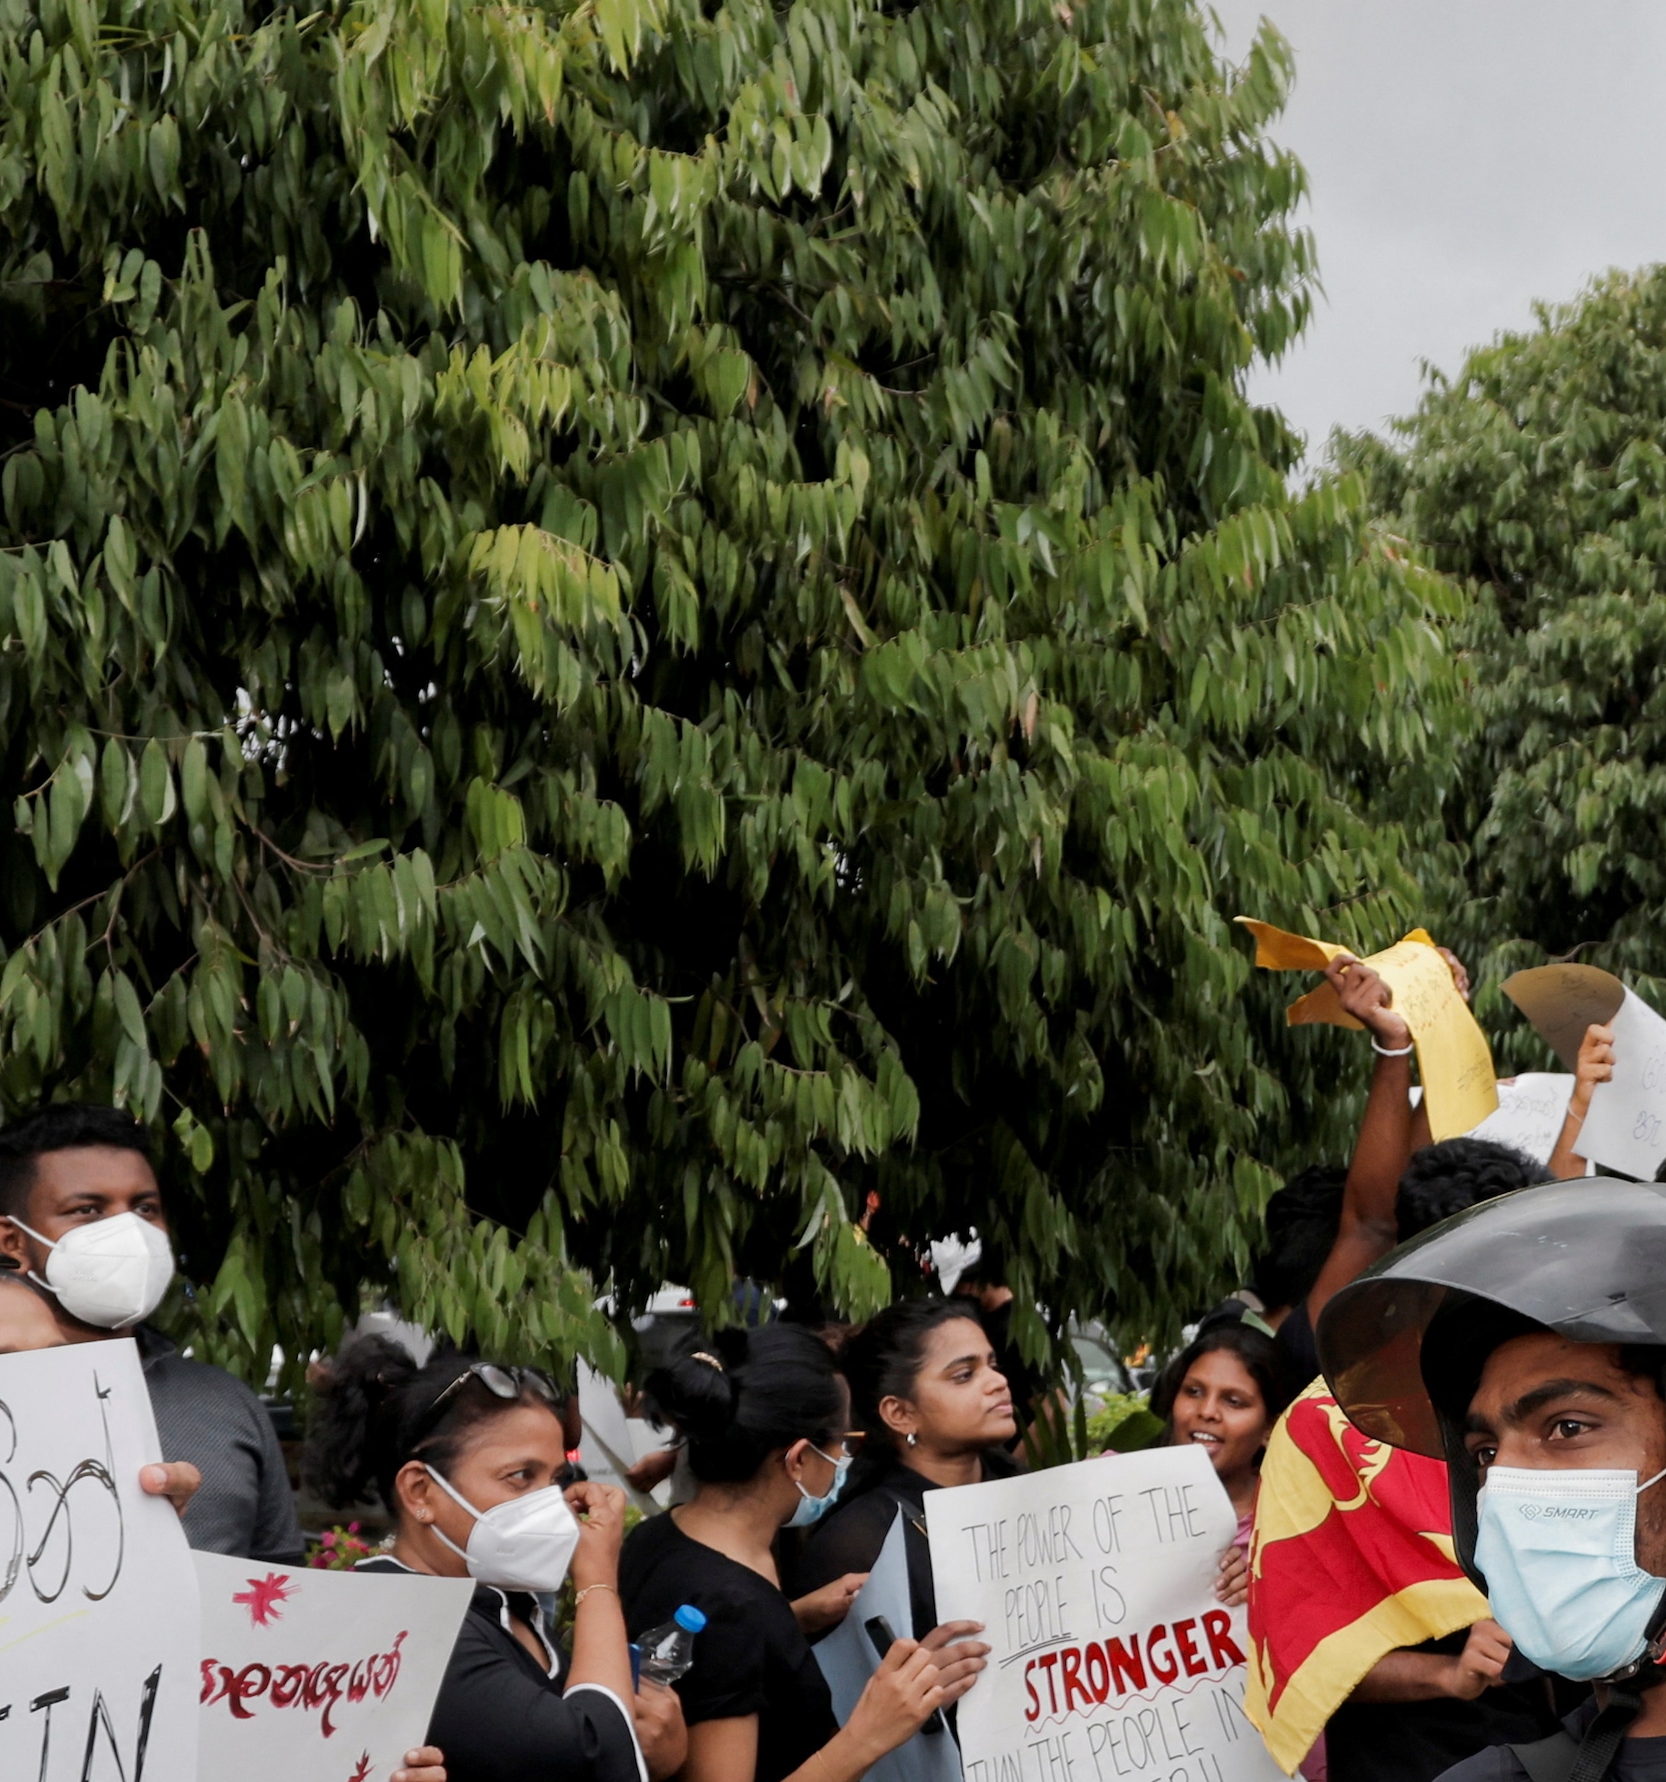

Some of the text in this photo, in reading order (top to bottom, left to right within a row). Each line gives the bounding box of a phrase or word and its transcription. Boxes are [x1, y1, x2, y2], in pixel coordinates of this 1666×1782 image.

[961, 1484, 1207, 1583] THE POWER OF THE
[1543, 1506, 1599, 1519] SMART
[1004, 1565, 1126, 1650] PEOPLE IS
[1023, 1609, 1247, 1722] STRONGER
[1086, 1698, 1205, 1782] PEOPLE
